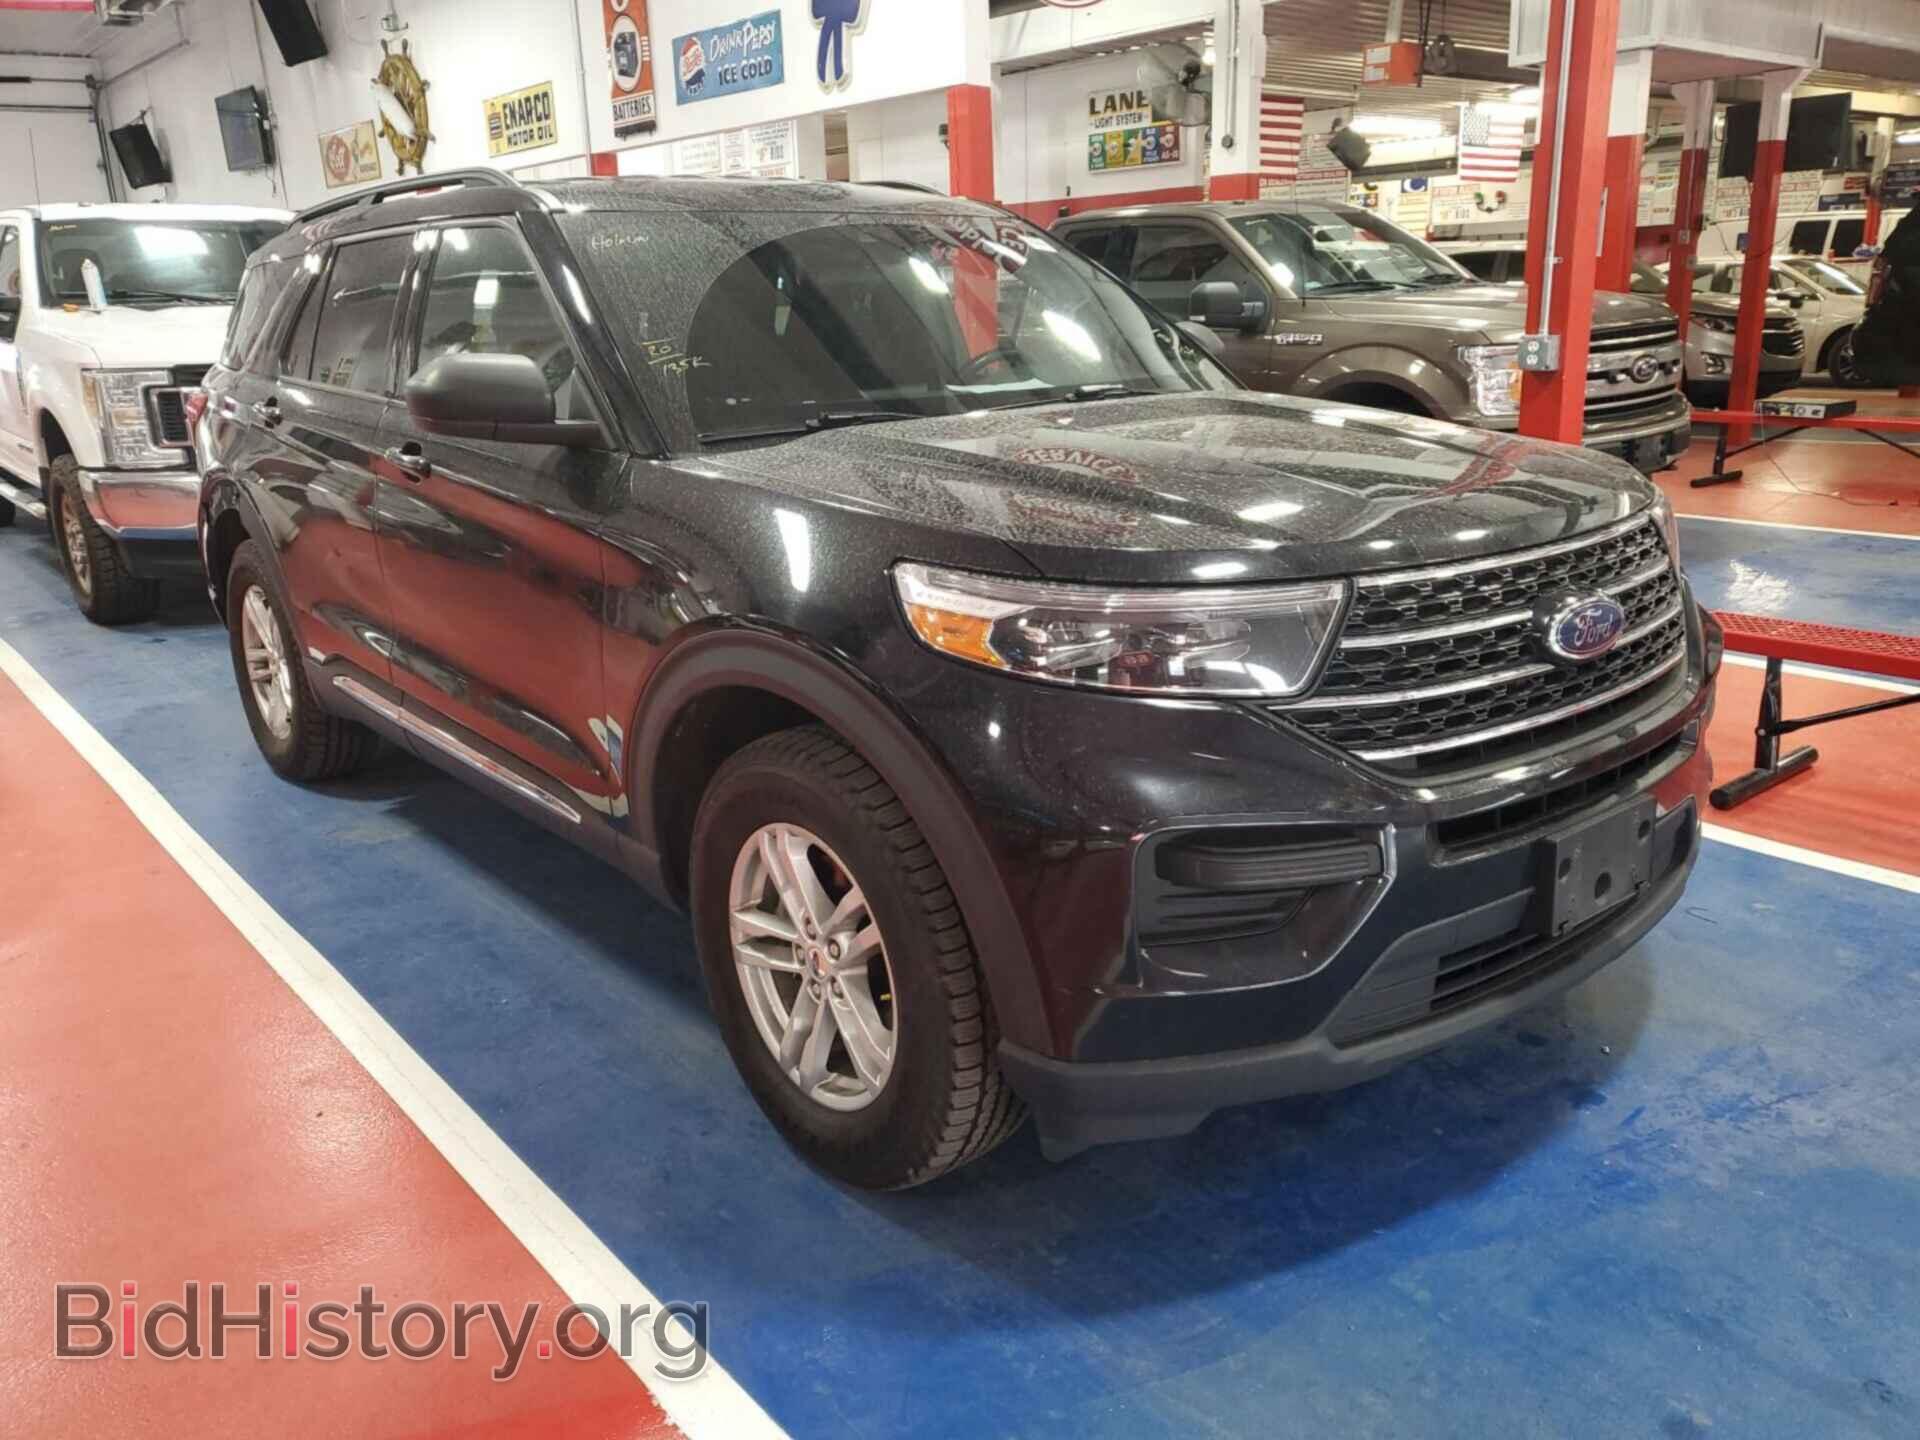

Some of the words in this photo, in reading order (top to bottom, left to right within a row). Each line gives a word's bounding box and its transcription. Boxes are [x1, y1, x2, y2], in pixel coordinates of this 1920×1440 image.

[710, 29, 743, 61] DRINK
[718, 62, 738, 85] ICE
[741, 56, 773, 81] COLD
[503, 91, 551, 130] ENARCO
[613, 96, 652, 121] BATTERIES
[1089, 90, 1149, 115] LANE
[1095, 115, 1114, 129] LIGHT
[1116, 111, 1142, 126] SYSTEM
[507, 128, 535, 146] MOTOR
[537, 124, 553, 140] OIL
[1573, 607, 1615, 647] Ford
